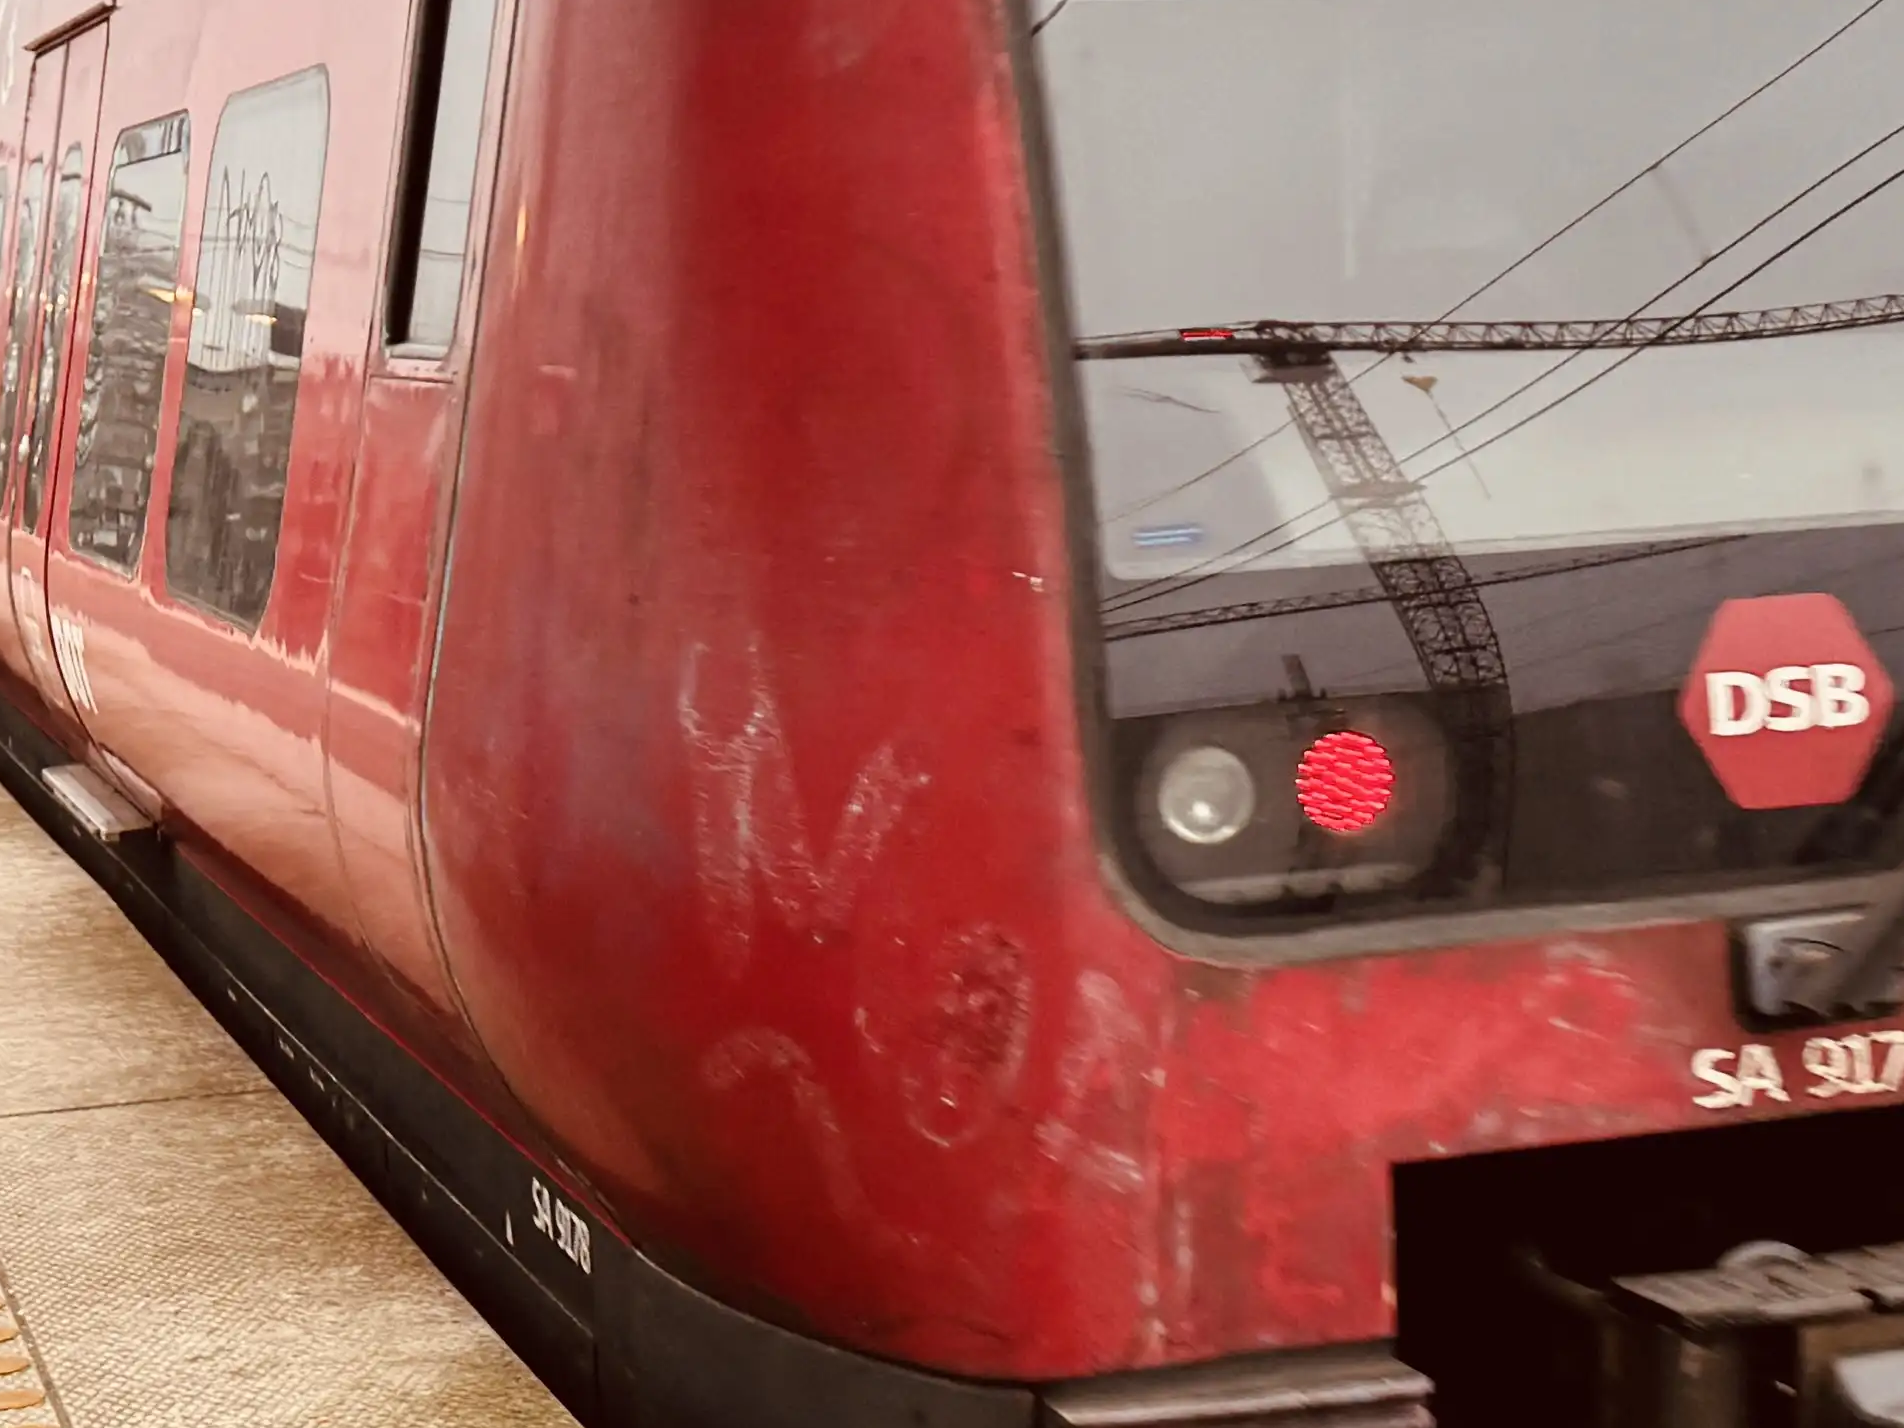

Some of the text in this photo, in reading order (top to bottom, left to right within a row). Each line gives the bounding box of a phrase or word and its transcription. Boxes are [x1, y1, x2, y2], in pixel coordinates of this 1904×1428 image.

[1705, 664, 1870, 736] DSB
[1691, 1043, 1791, 1109] SA
[532, 1176, 554, 1241] SA
